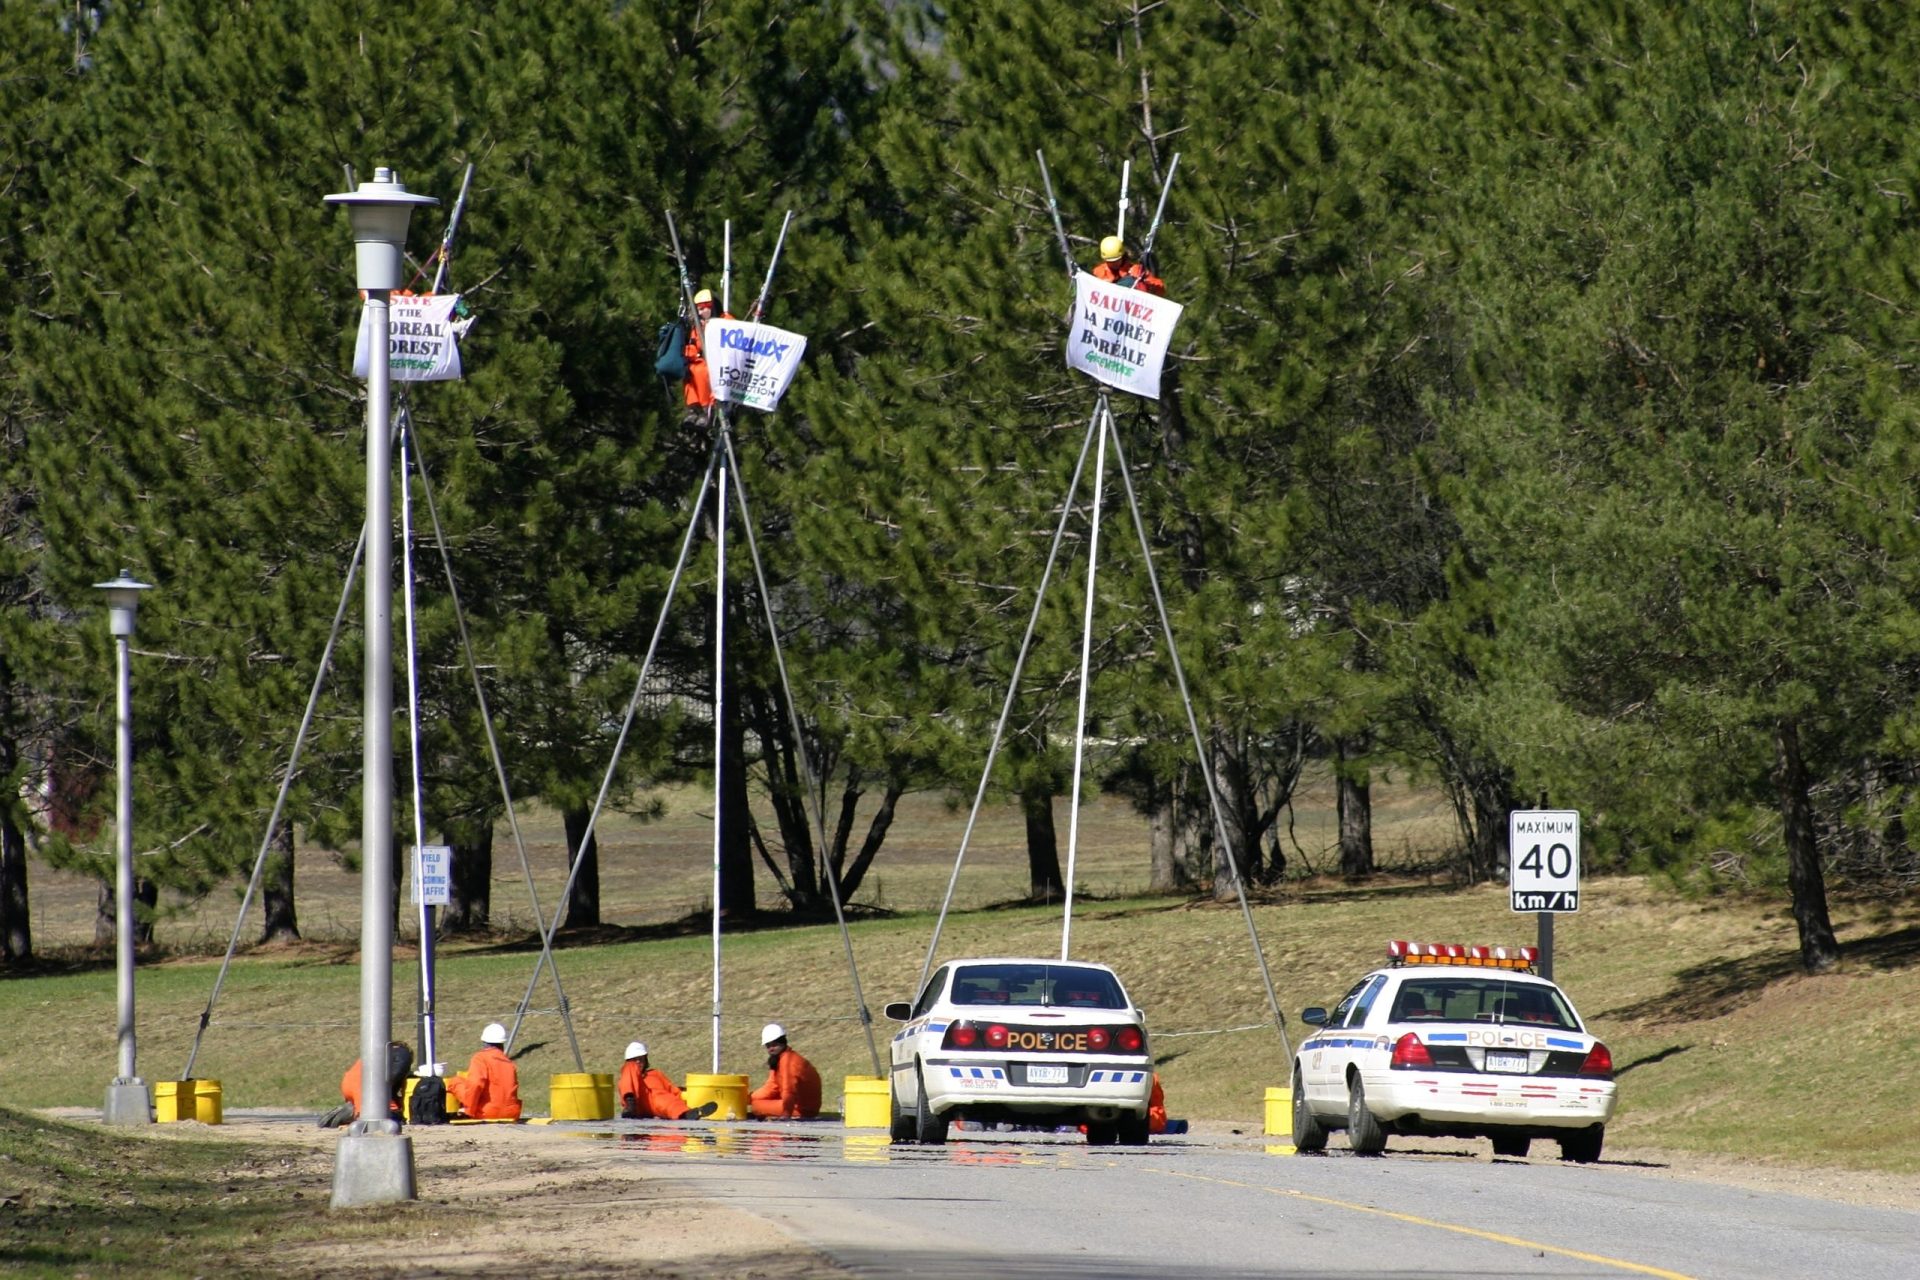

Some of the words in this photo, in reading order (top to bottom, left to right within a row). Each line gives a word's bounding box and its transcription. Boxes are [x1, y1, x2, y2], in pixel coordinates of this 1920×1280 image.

[398, 308, 422, 318] THE
[1089, 290, 1154, 322] SAUVEZ
[389, 321, 444, 337] OREAL
[1102, 317, 1155, 345] FORÊT
[389, 340, 442, 356] OREST
[719, 366, 779, 389] FOREST
[1517, 822, 1573, 834] MAXIMUM
[426, 864, 436, 874] TO
[1518, 842, 1572, 879] 40
[423, 886, 446, 896] AFFIC
[1515, 892, 1576, 909] km/h
[1007, 1031, 1088, 1051] POLICE
[1468, 1031, 1546, 1048] POLICE
